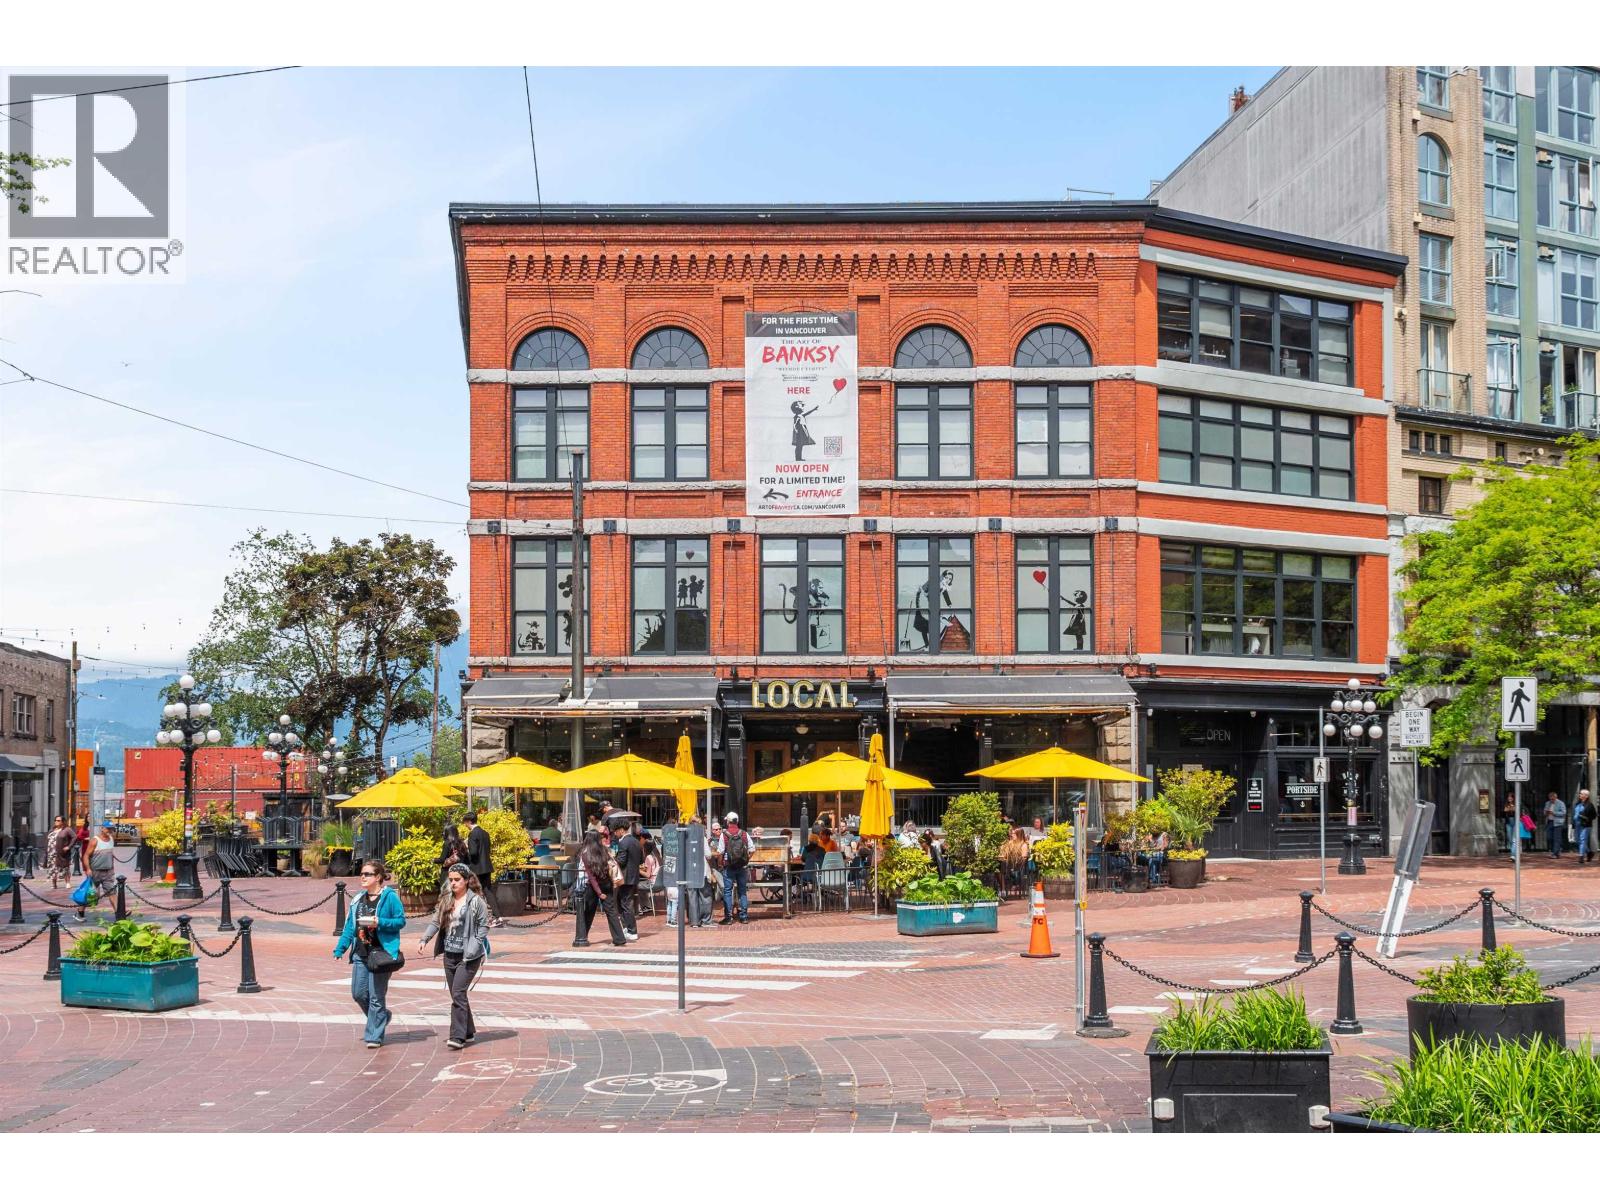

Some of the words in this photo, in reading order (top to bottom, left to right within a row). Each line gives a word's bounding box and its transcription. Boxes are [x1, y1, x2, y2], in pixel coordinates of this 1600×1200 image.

[761, 317, 778, 325] FOR
[779, 317, 794, 325] THE
[819, 316, 839, 324] TIME
[775, 327, 784, 335] IN
[762, 345, 840, 365] BANKSY
[787, 386, 811, 395] HERE
[775, 464, 801, 473] NOW
[802, 464, 829, 473] OPEN
[759, 477, 776, 485] FOR
[786, 476, 821, 485] LIMITED
[822, 475, 846, 484] TIME!
[796, 488, 843, 499] ENTRANCE
[751, 680, 854, 709] LOCAL
[1408, 718, 1421, 726] ONE
[1206, 729, 1231, 741] OPEN
[1286, 785, 1319, 794] PORTSIDE
[1033, 917, 1044, 925] TC
